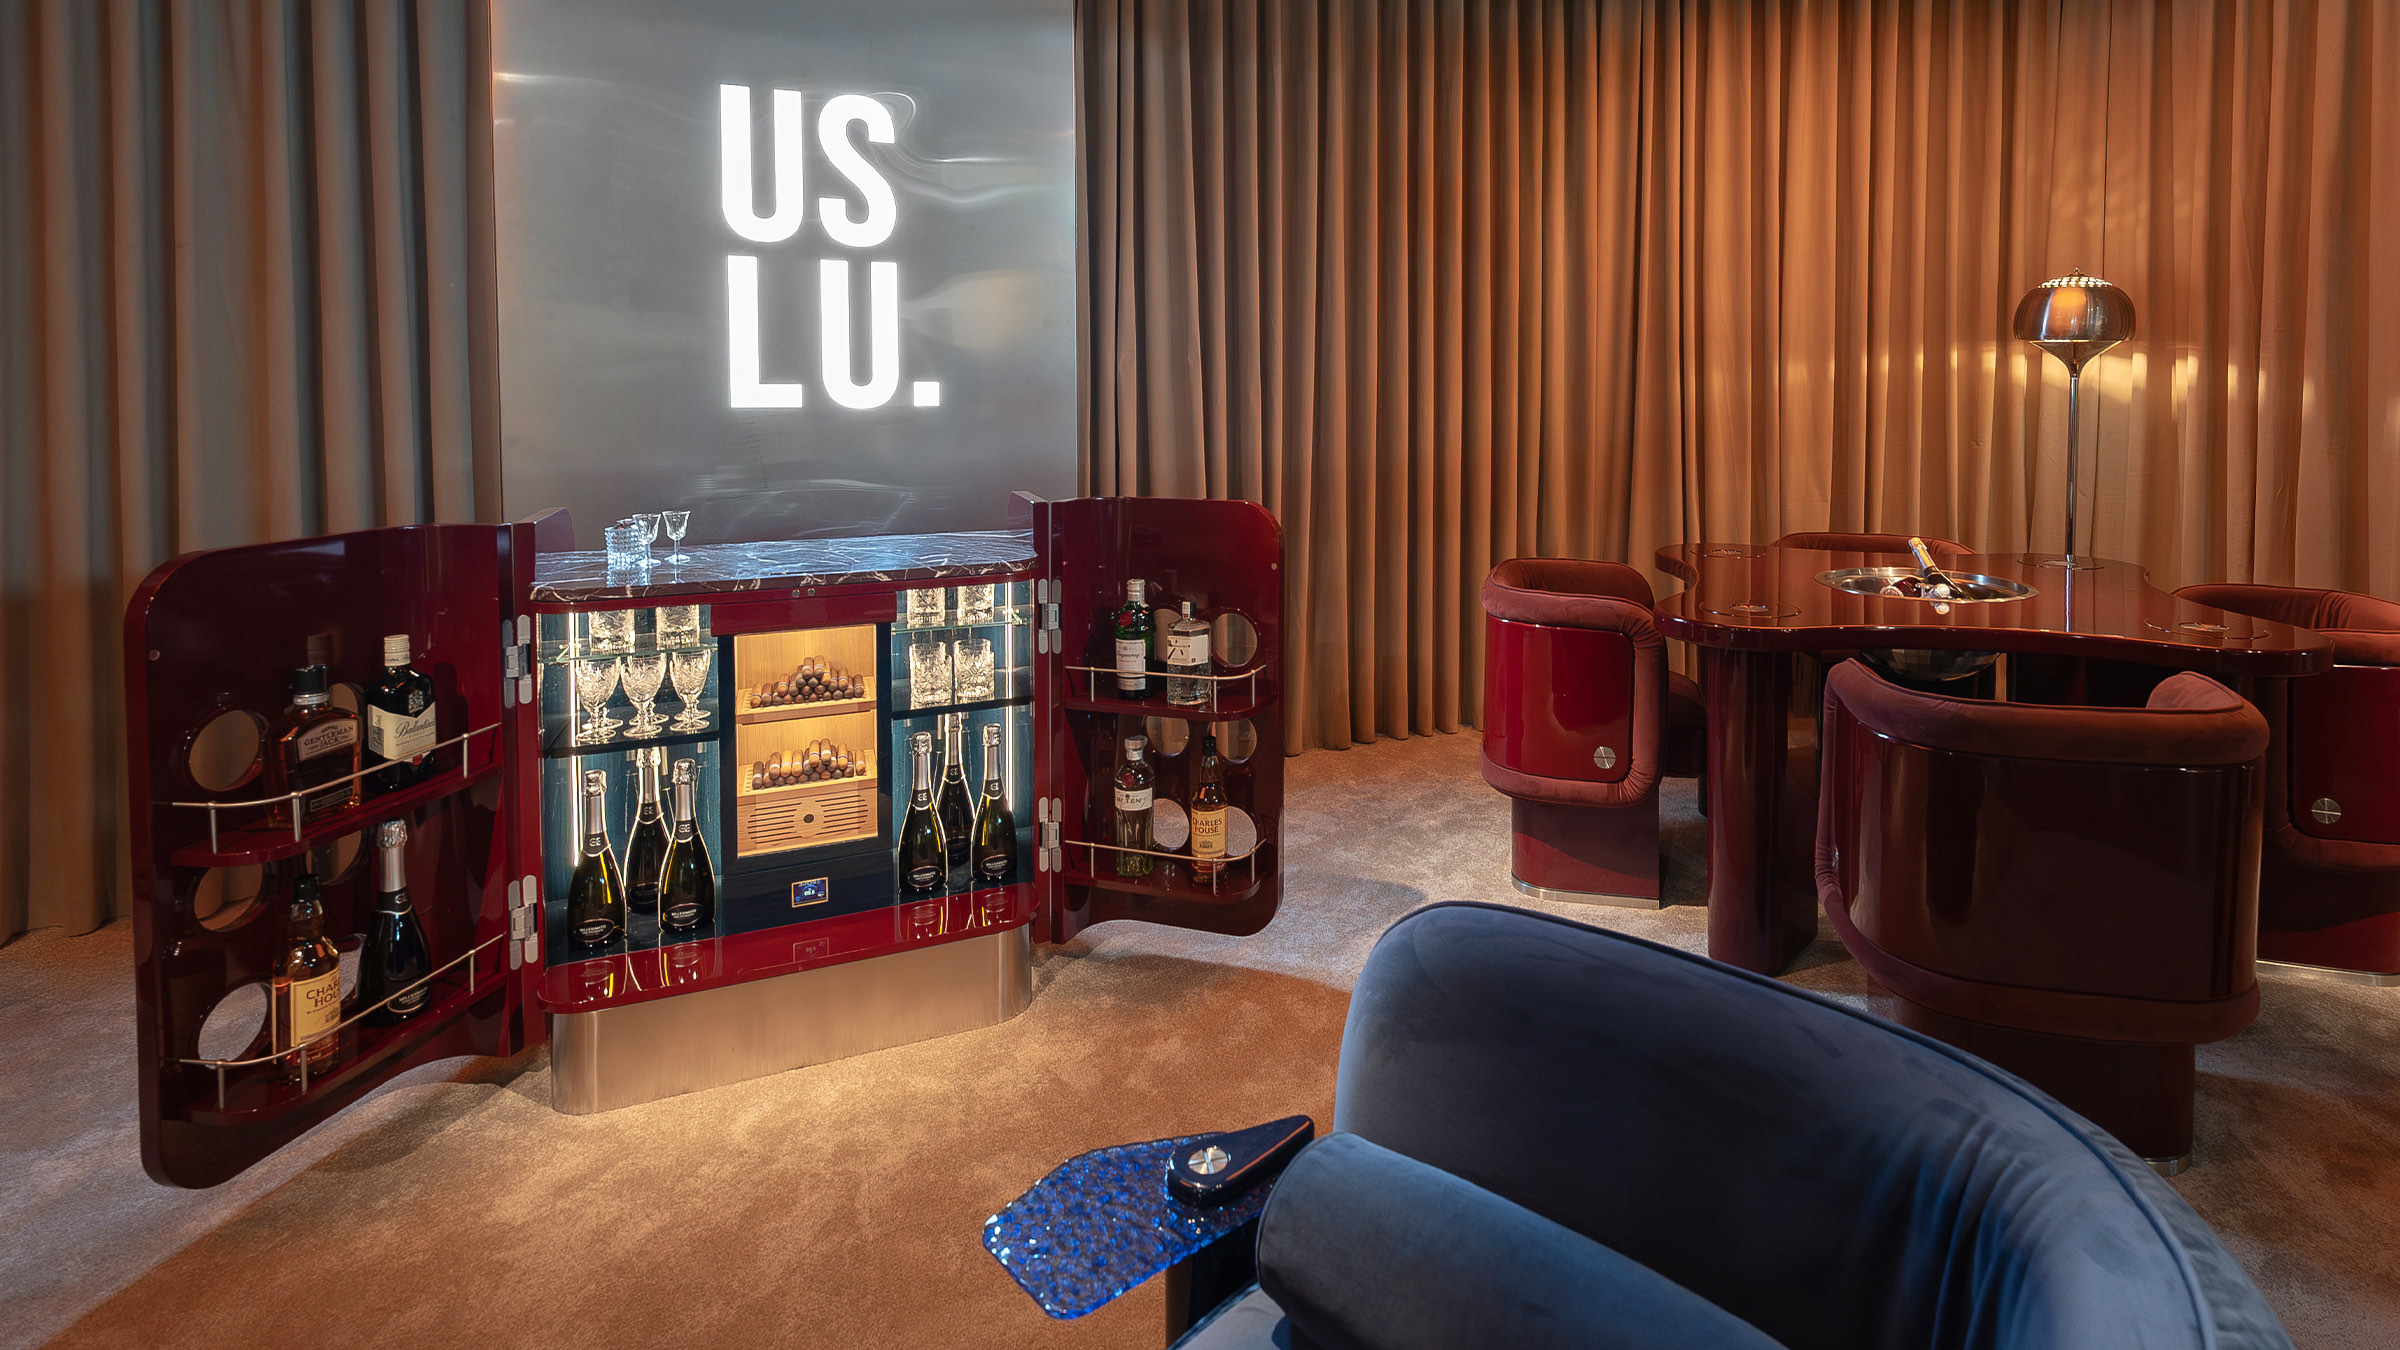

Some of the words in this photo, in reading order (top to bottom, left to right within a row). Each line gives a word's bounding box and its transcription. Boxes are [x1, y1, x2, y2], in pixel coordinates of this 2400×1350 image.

[720, 84, 896, 247] US
[727, 255, 940, 409] LU.
[304, 724, 354, 746] GENTLEMAN
[320, 737, 340, 750] JACK
[1192, 817, 1223, 827] CHARLES
[1194, 825, 1219, 834] HOUSE
